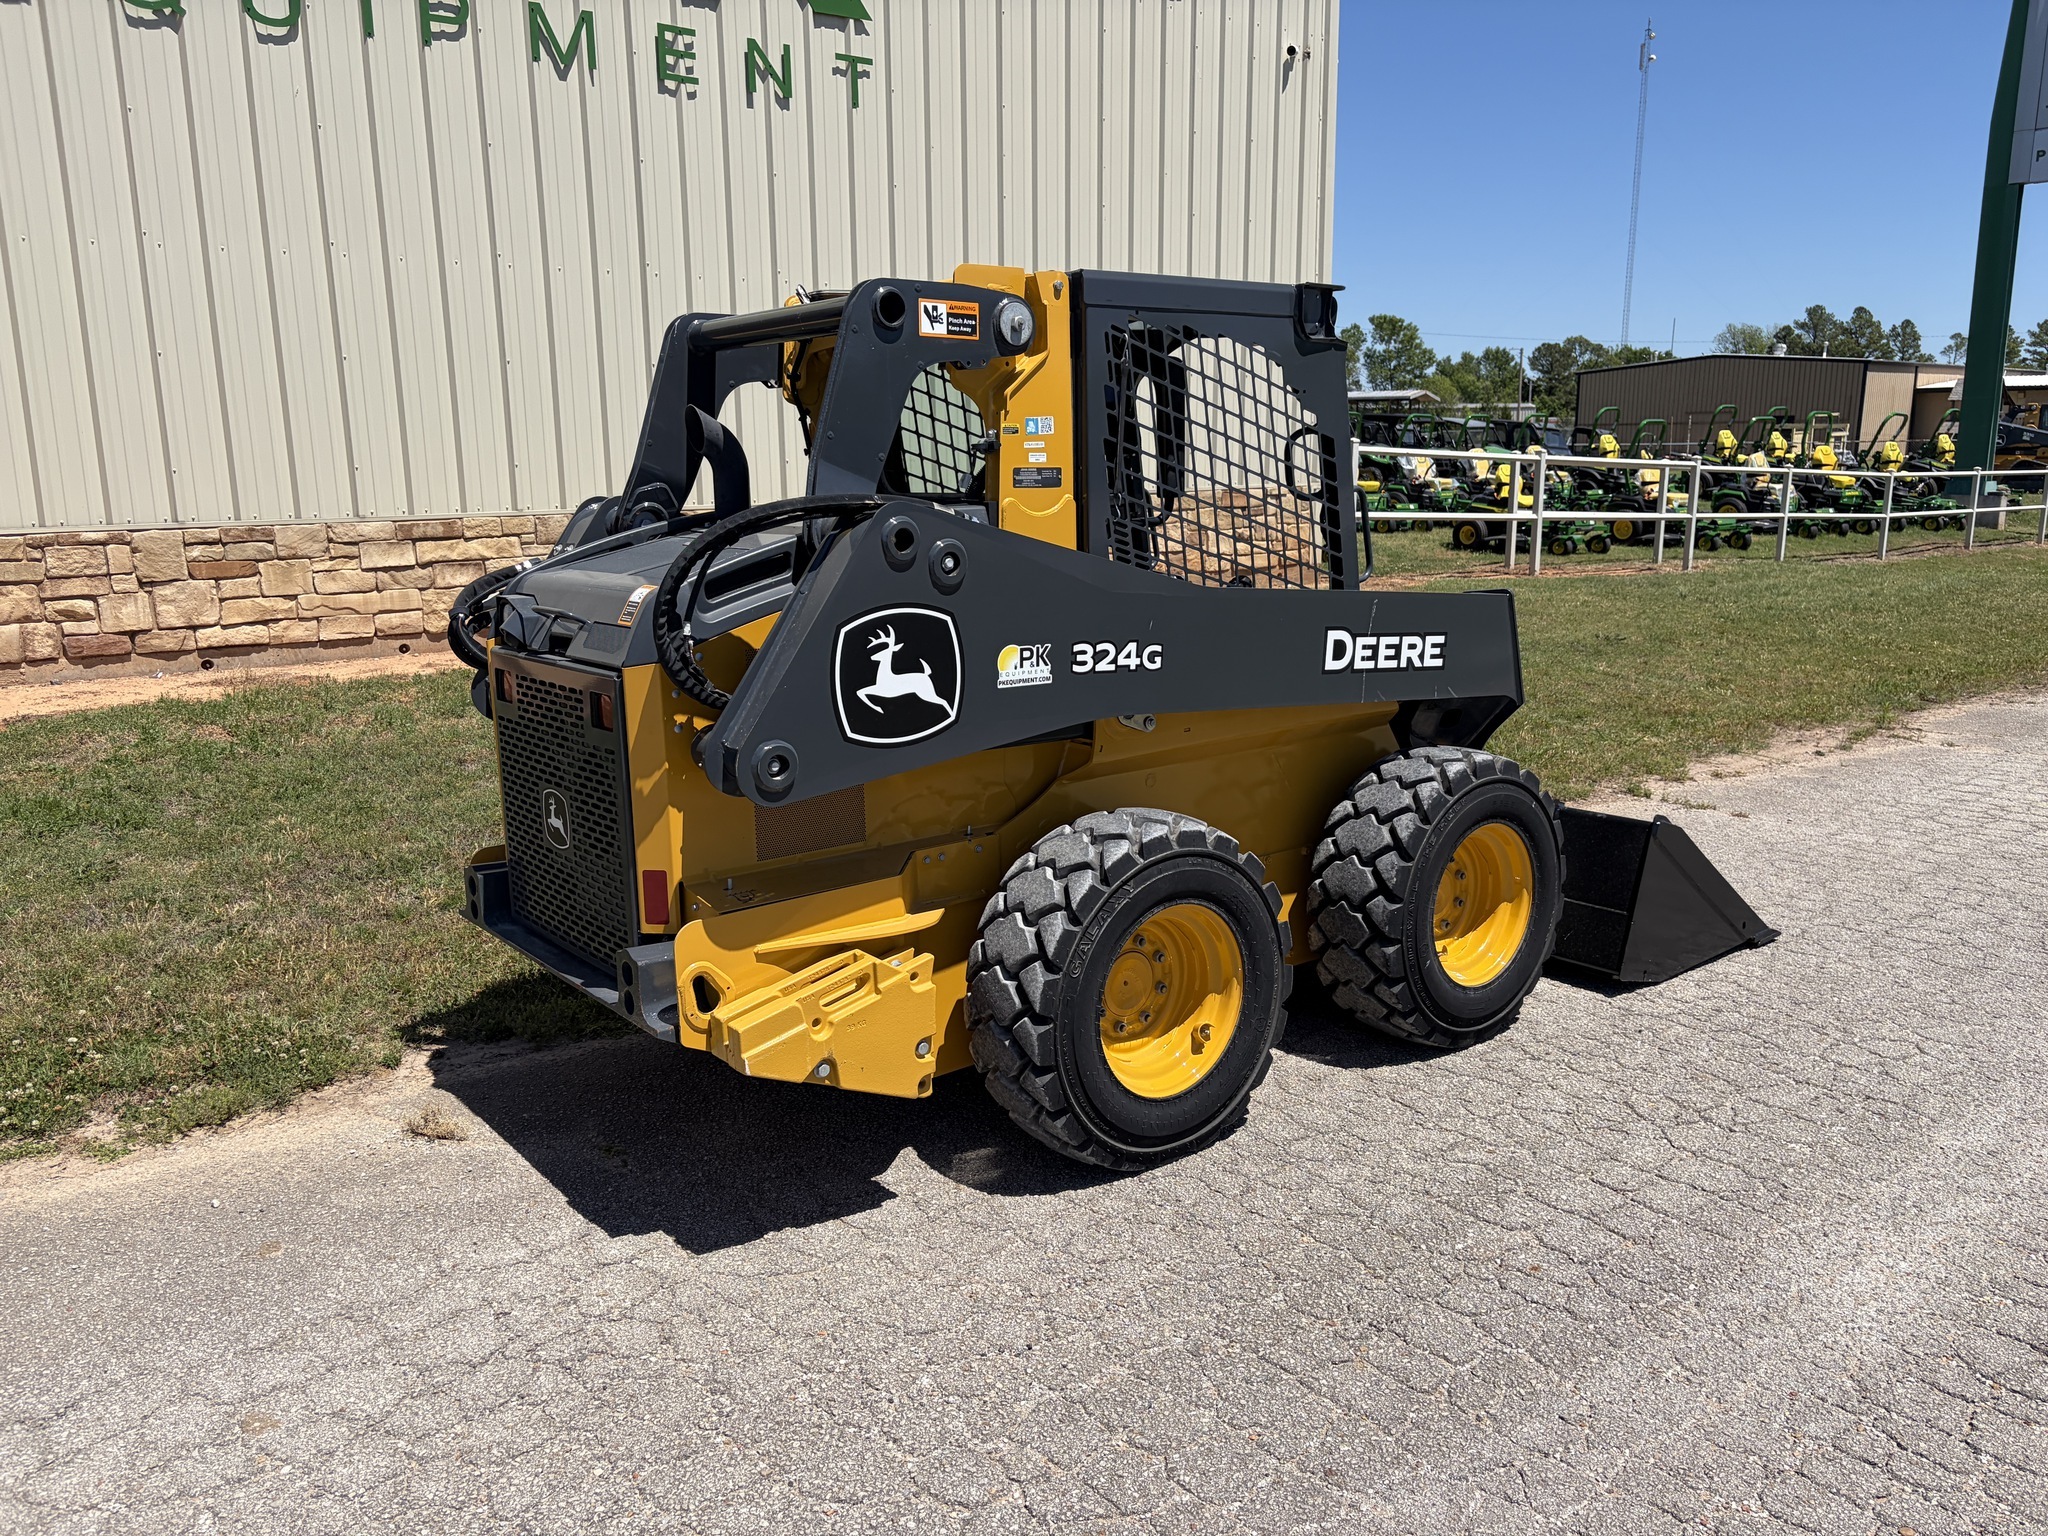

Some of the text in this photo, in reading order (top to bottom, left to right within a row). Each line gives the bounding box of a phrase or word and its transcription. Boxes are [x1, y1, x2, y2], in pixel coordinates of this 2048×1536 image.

[122, 0, 873, 108] IPMENT
[1072, 641, 1162, 673] 324G
[1324, 629, 1446, 671] DEERE
[998, 676, 1052, 687] PKEQUIPMENT.COM
[999, 668, 1050, 678] EQUIPMENT
[1069, 880, 1135, 978] GALAXY
